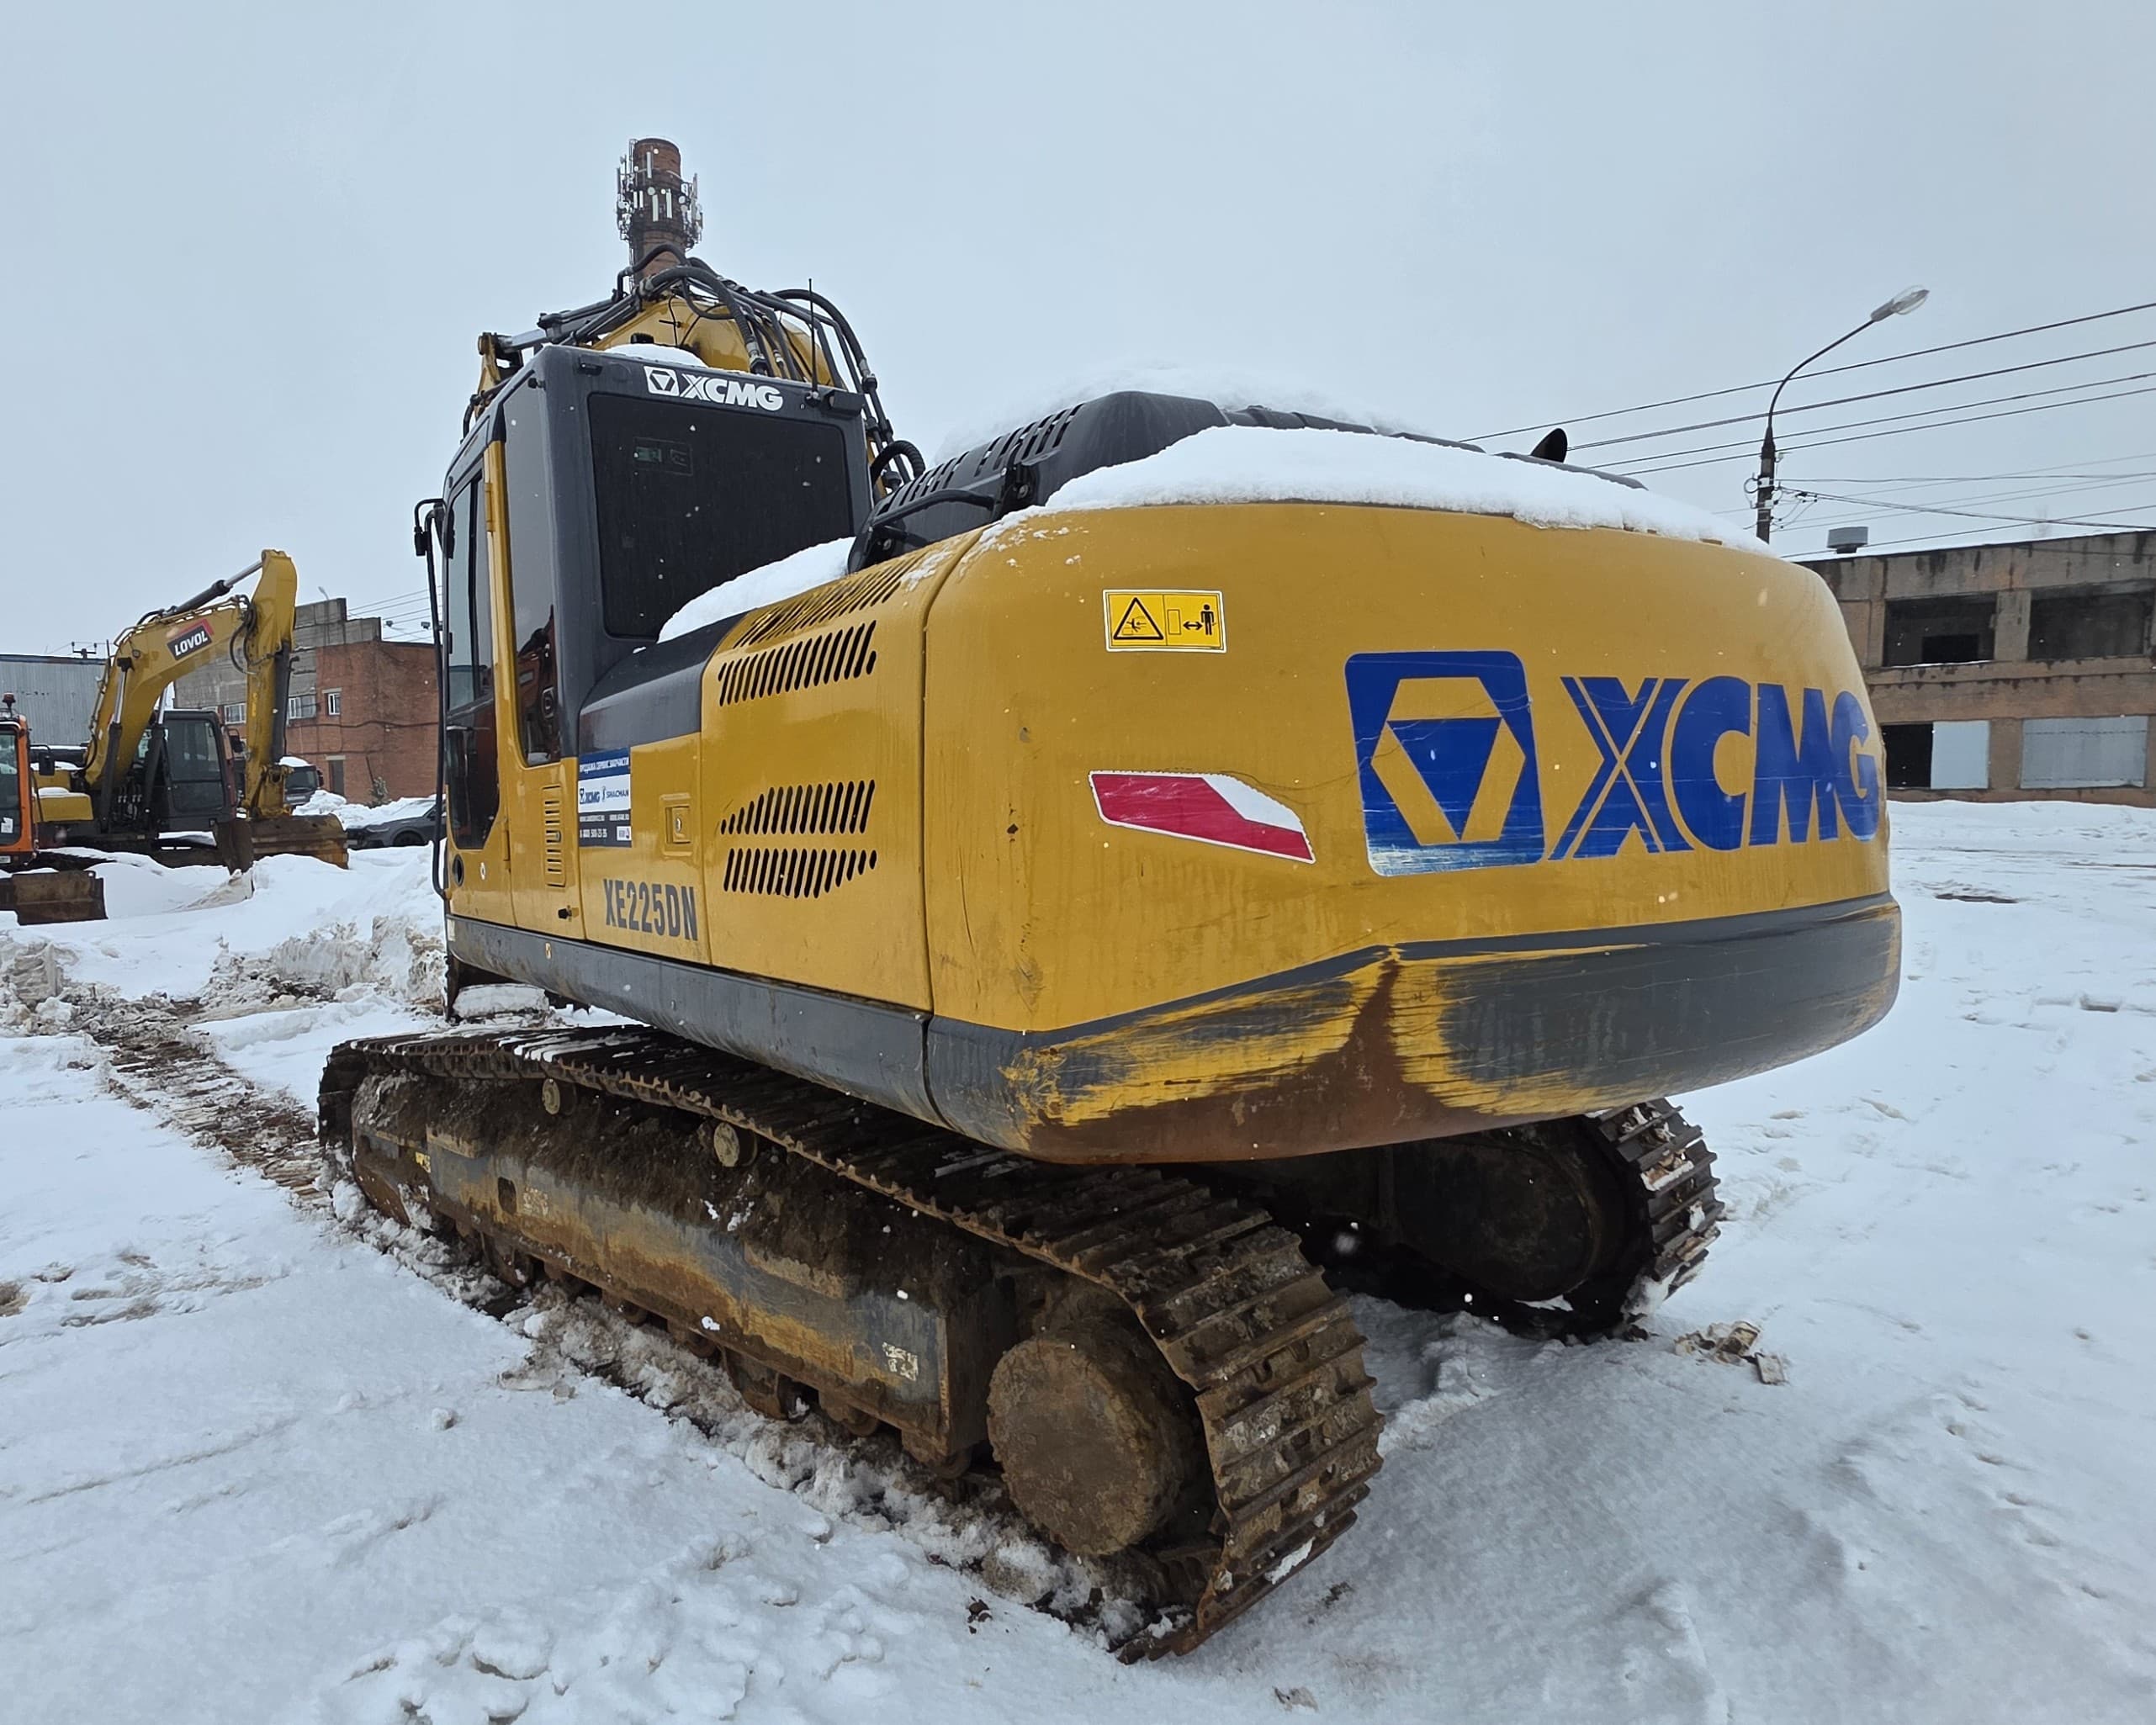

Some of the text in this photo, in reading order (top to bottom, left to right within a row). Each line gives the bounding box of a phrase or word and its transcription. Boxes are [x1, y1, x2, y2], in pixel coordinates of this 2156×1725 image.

[680, 373, 784, 411] XCMG
[174, 631, 209, 656] LOVOL
[1548, 675, 1881, 861] XCMG
[603, 878, 698, 941] XE225DN
